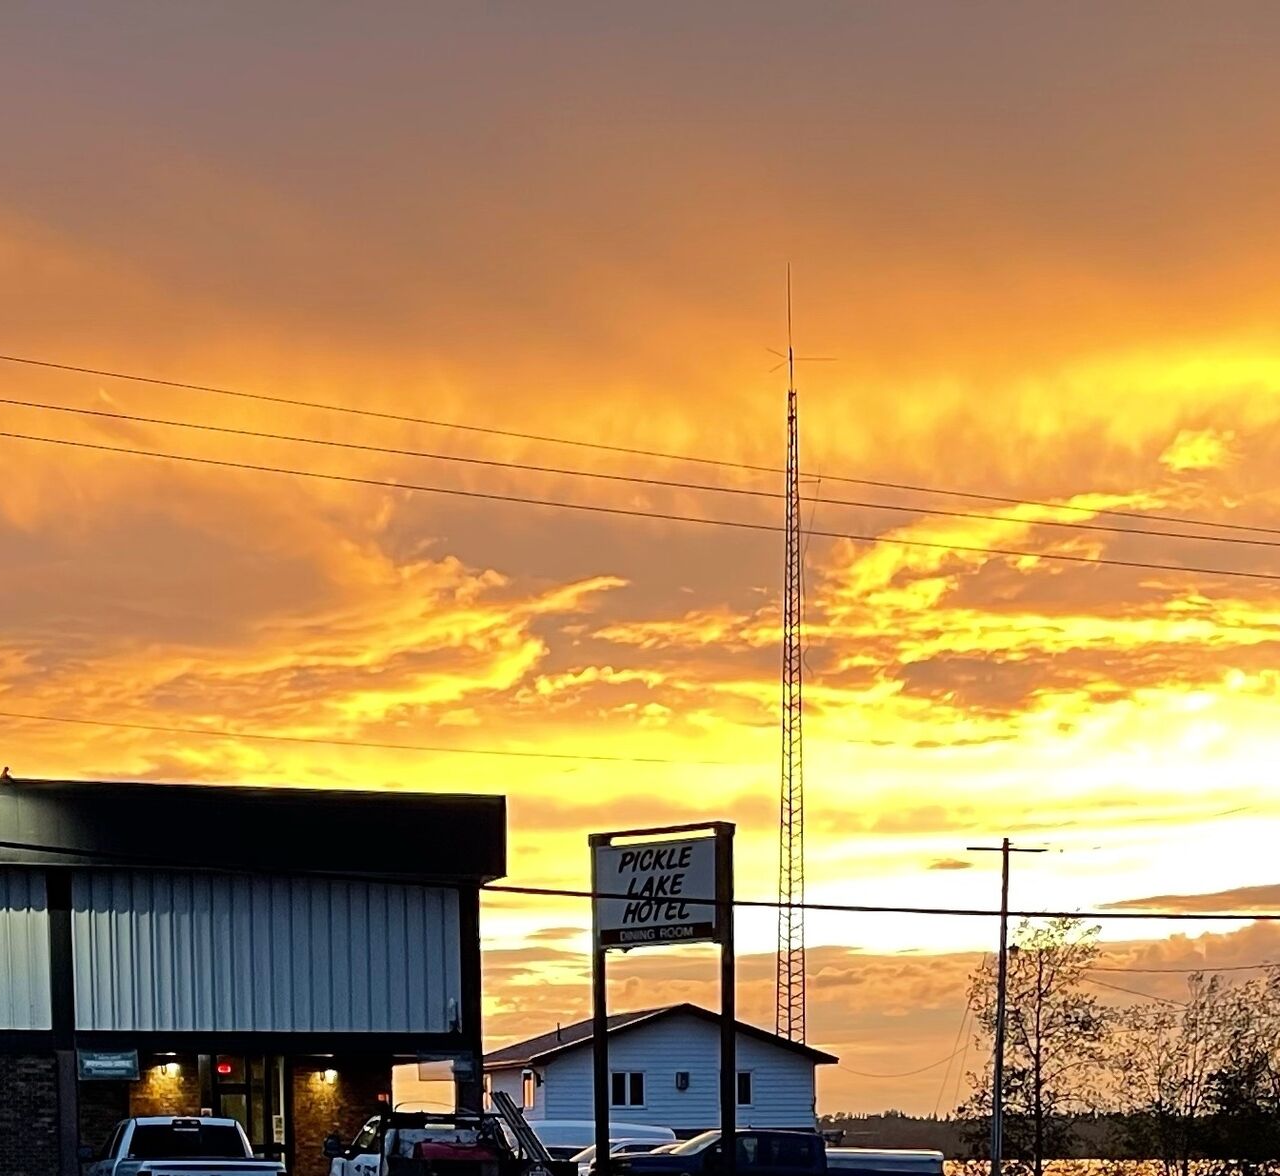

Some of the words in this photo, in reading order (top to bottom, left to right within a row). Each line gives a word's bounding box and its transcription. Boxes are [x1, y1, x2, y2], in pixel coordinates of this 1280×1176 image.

[618, 846, 693, 873] PICKLE
[627, 873, 685, 898] LAKE
[622, 900, 690, 924] HOTEL
[620, 928, 656, 942] DINING
[660, 926, 694, 938] ROOM
